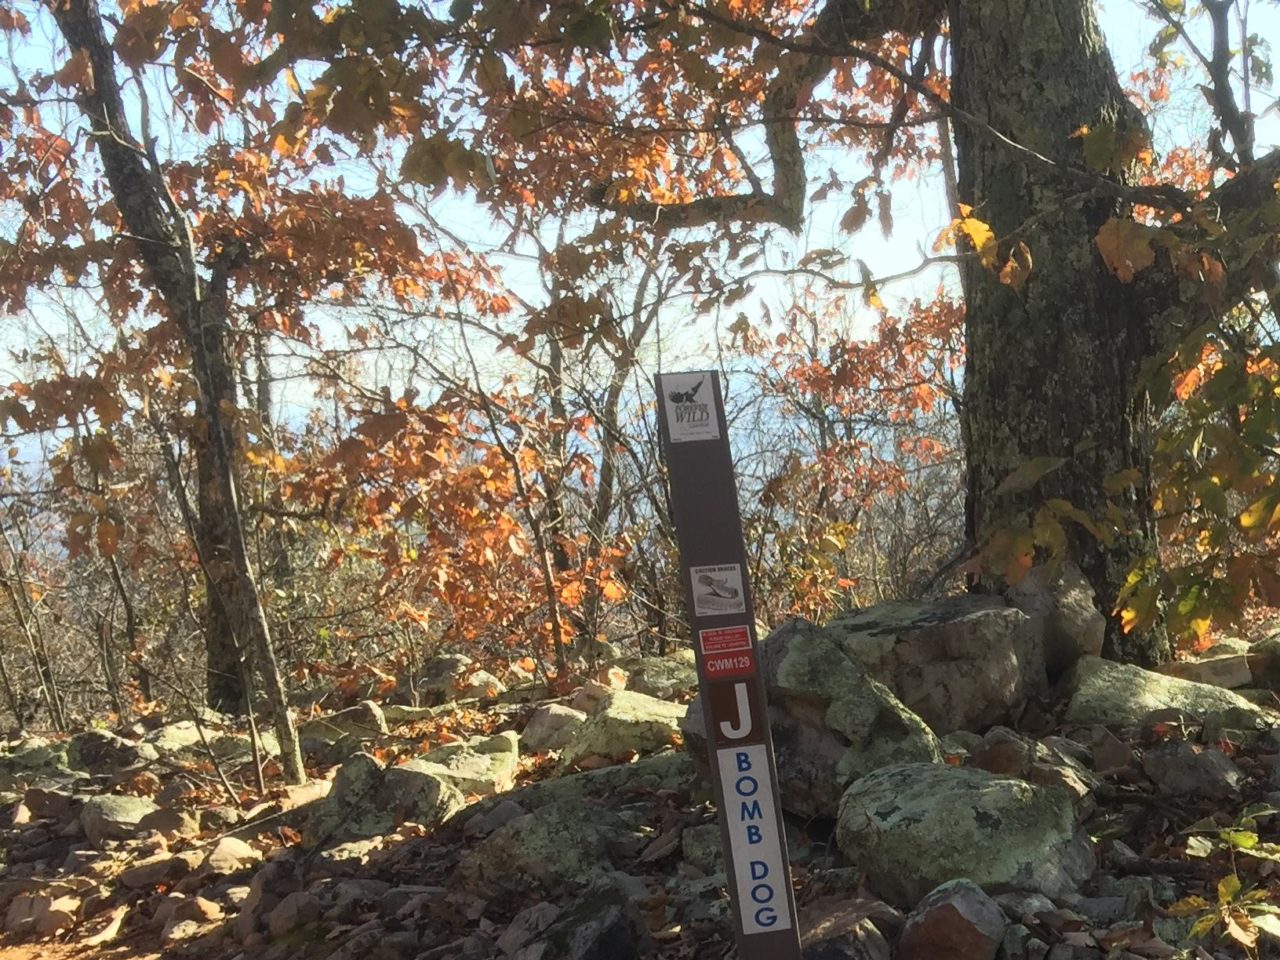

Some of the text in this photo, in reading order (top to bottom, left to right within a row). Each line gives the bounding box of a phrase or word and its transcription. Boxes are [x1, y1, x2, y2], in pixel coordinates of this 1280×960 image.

[675, 409, 710, 423] WILD
[707, 656, 750, 672] CWM129
[720, 682, 752, 739] J
[735, 752, 778, 927] BOMB DOG
